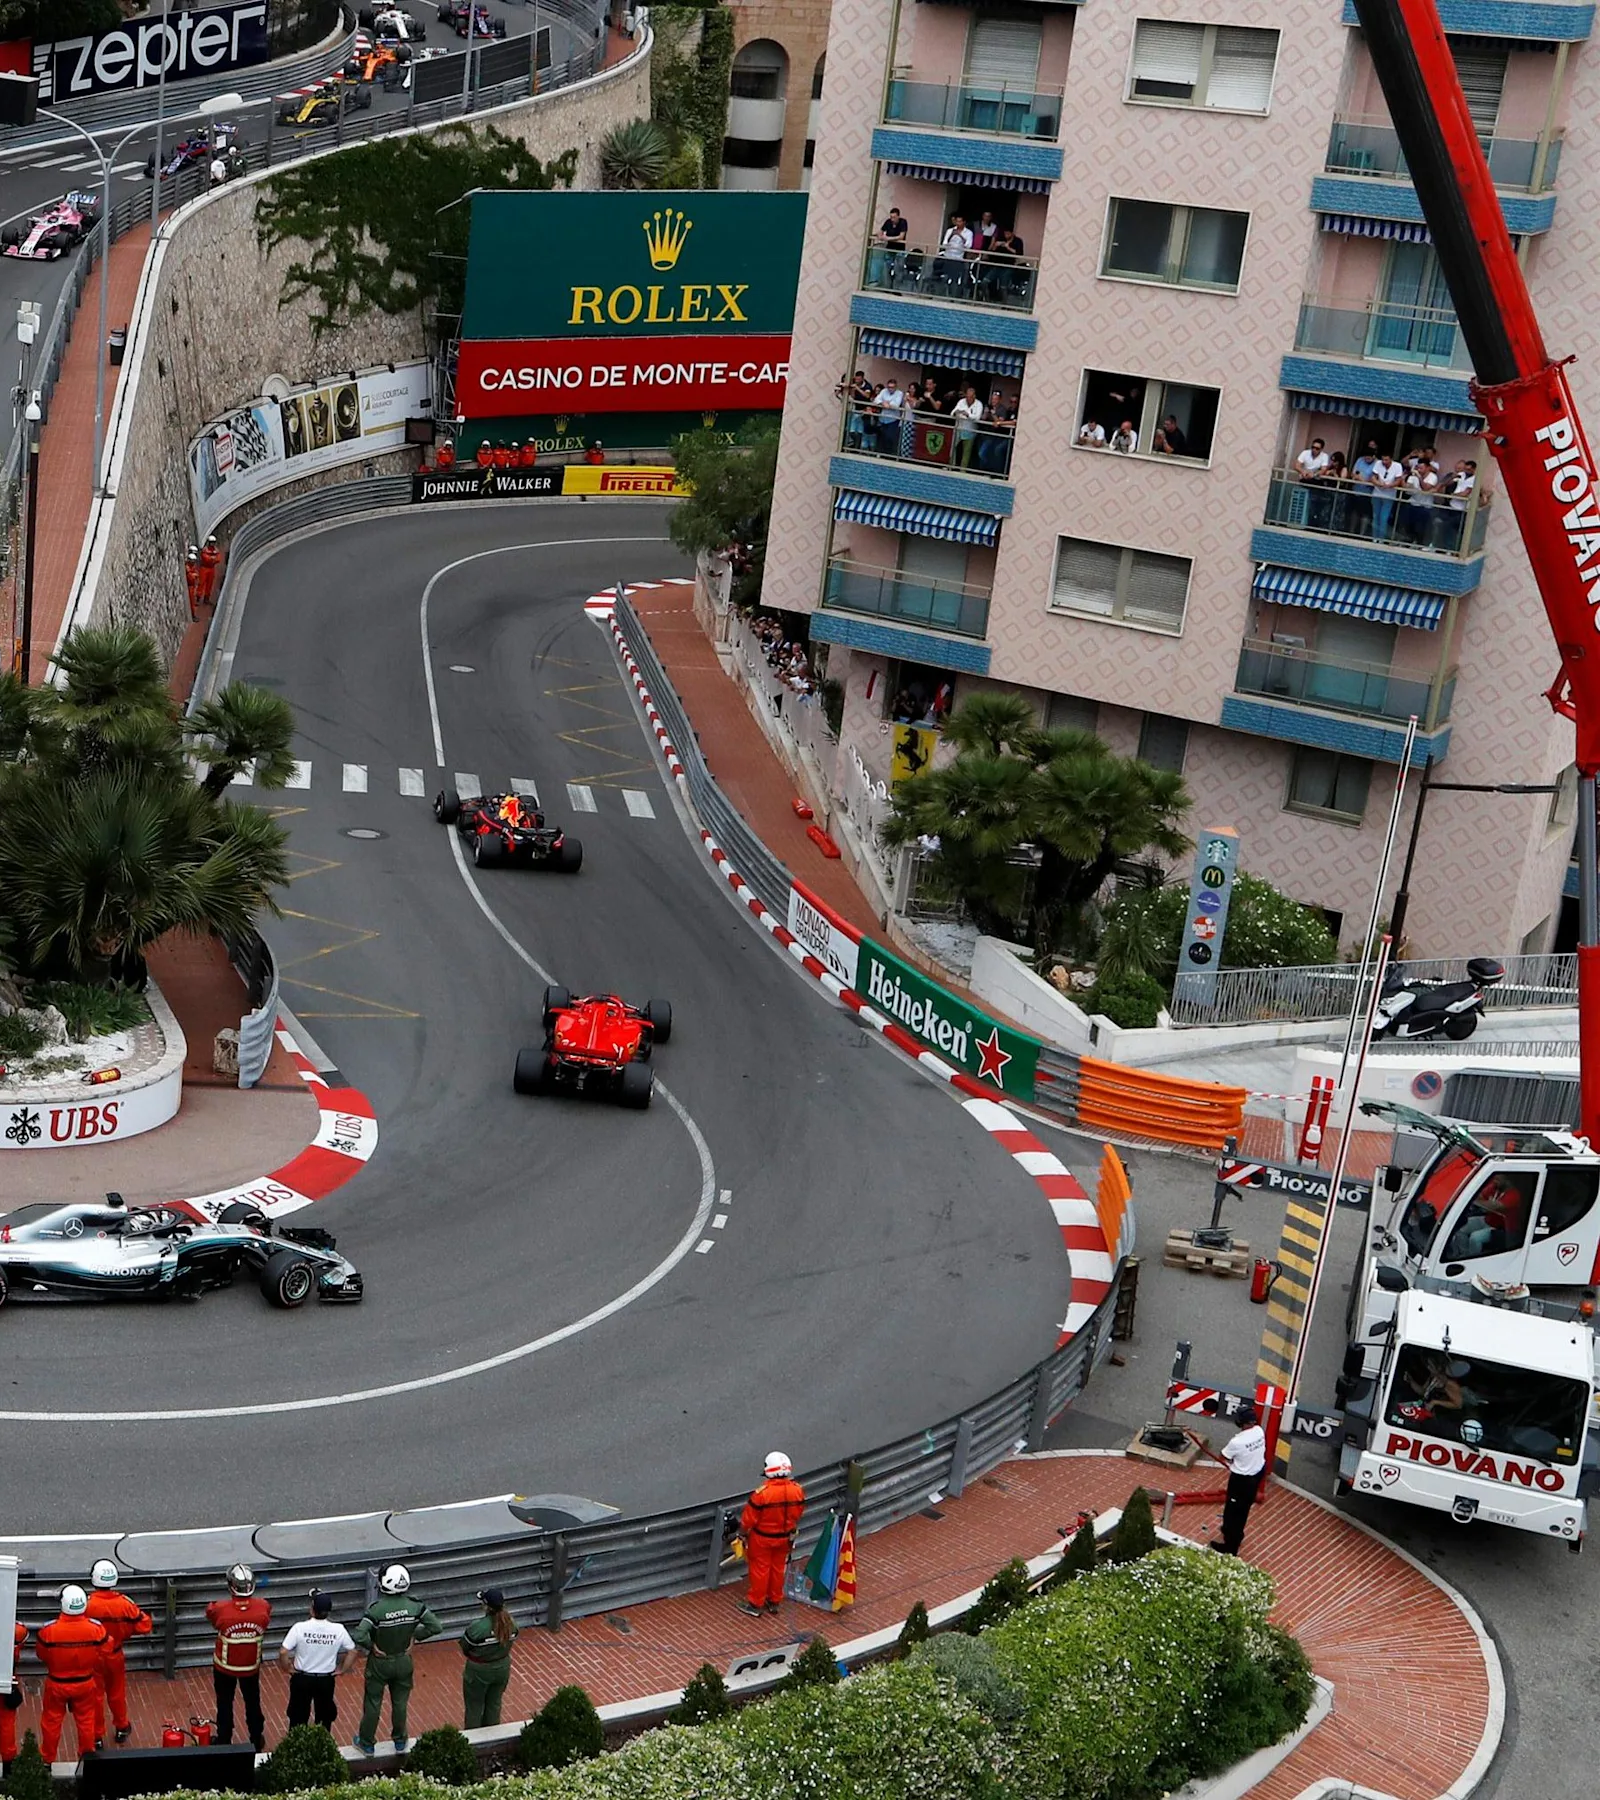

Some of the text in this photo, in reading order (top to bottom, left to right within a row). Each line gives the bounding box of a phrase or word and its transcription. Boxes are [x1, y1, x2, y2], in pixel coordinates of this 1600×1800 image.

[54, 5, 266, 92] zepter
[567, 284, 749, 324] ROLEX
[479, 365, 583, 391] CASINO
[589, 364, 627, 387] DE
[534, 436, 586, 452] ROLEX
[421, 476, 552, 499] JOHNNIE WALKER
[600, 472, 675, 492] PIRELLI
[796, 897, 830, 945] MONACO
[868, 958, 968, 1062] Heineken
[49, 1102, 119, 1142] UBS
[334, 1113, 363, 1139] UBS
[89, 1264, 155, 1277] PETRONAS
[1386, 1433, 1565, 1492] PIOVANO
[385, 1609, 409, 1620] DOCTOR
